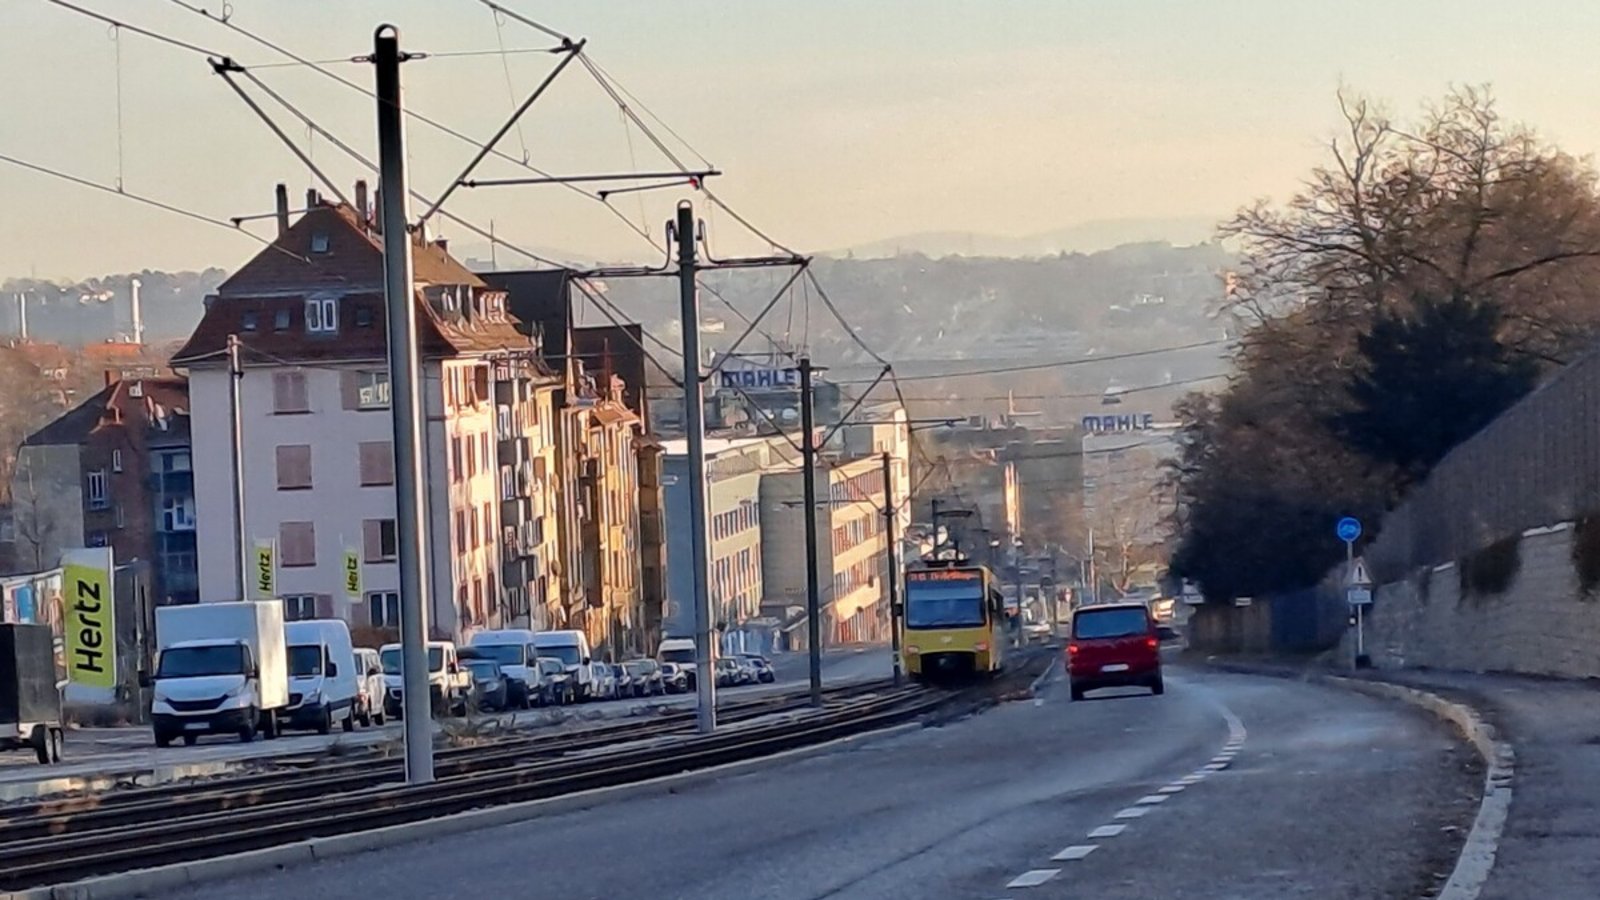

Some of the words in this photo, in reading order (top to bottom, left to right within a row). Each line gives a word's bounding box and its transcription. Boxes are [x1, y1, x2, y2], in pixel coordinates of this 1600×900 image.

[721, 369, 796, 387] MAHLE
[1082, 414, 1152, 431] MAHLE
[259, 552, 271, 591] Hertz
[347, 556, 358, 592] Hertz
[74, 579, 104, 673] Hertz
